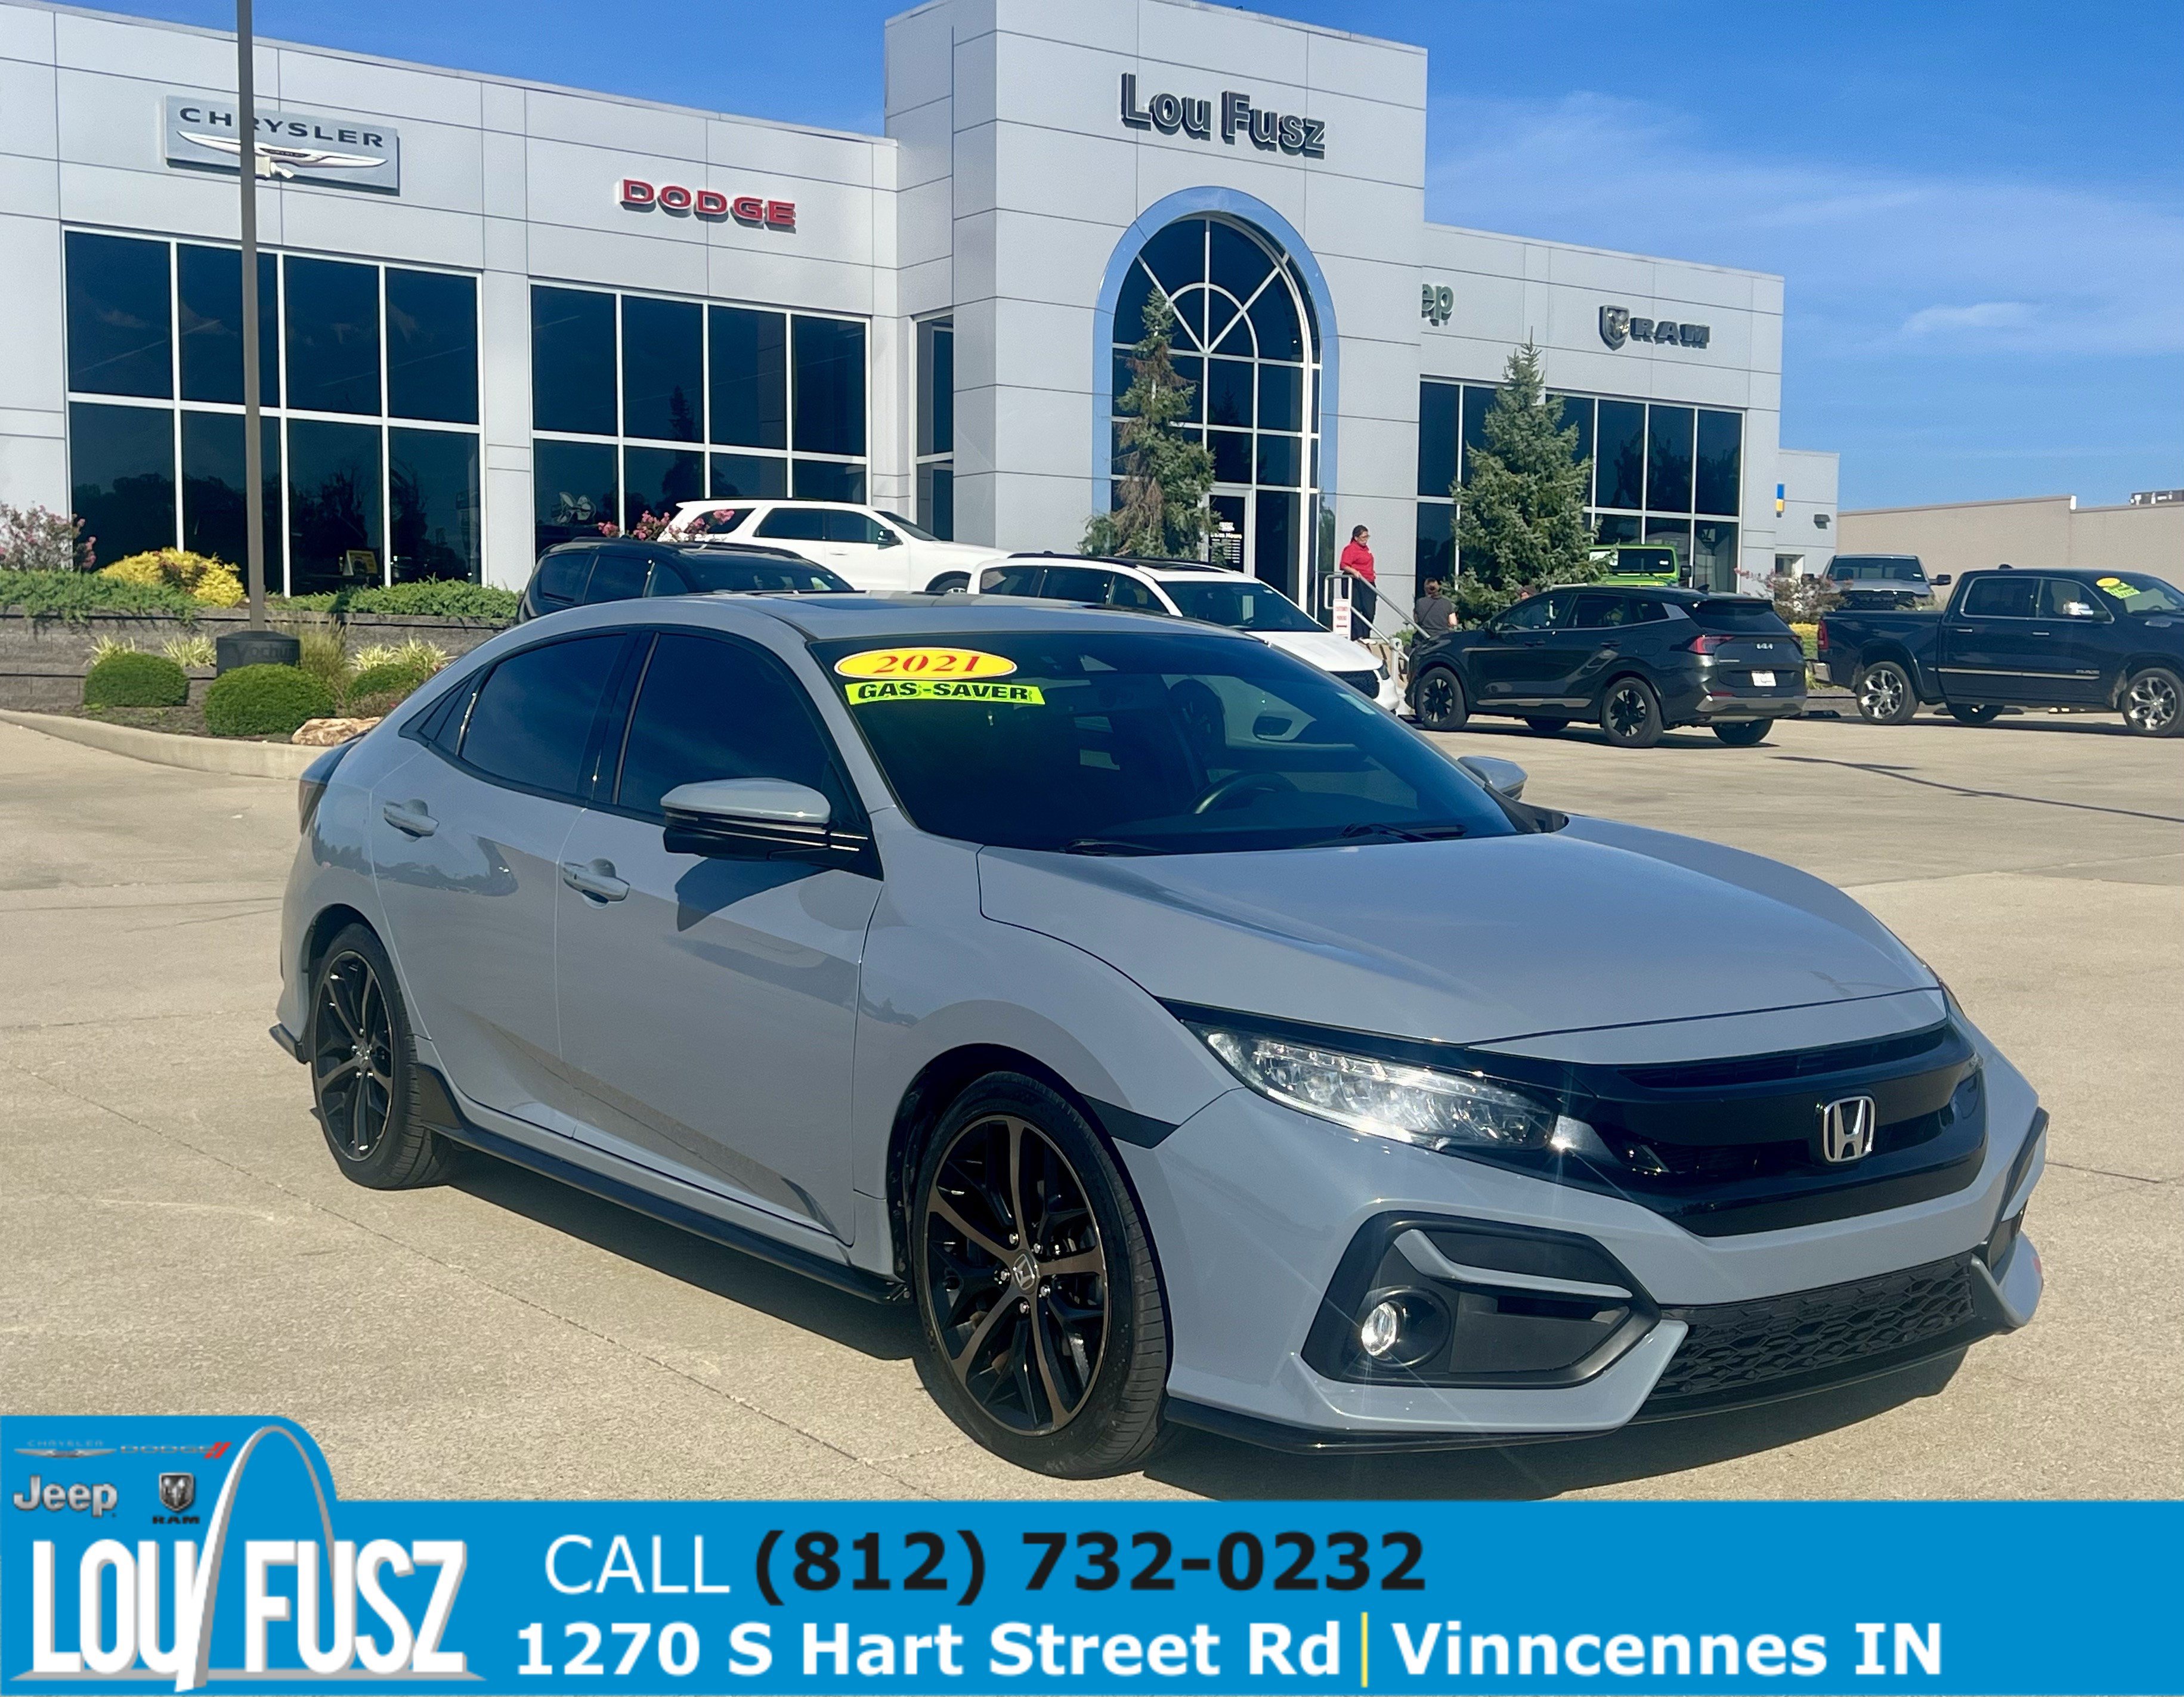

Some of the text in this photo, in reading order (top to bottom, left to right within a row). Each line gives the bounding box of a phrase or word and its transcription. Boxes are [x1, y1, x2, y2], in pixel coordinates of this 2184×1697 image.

[1121, 73, 1325, 157] Lou Fusz
[623, 179, 796, 229] DODGE
[1422, 283, 1454, 325] ep
[1630, 317, 1710, 348] RAM
[874, 655, 982, 674] 2021
[858, 682, 1032, 702] GAS-SAVER
